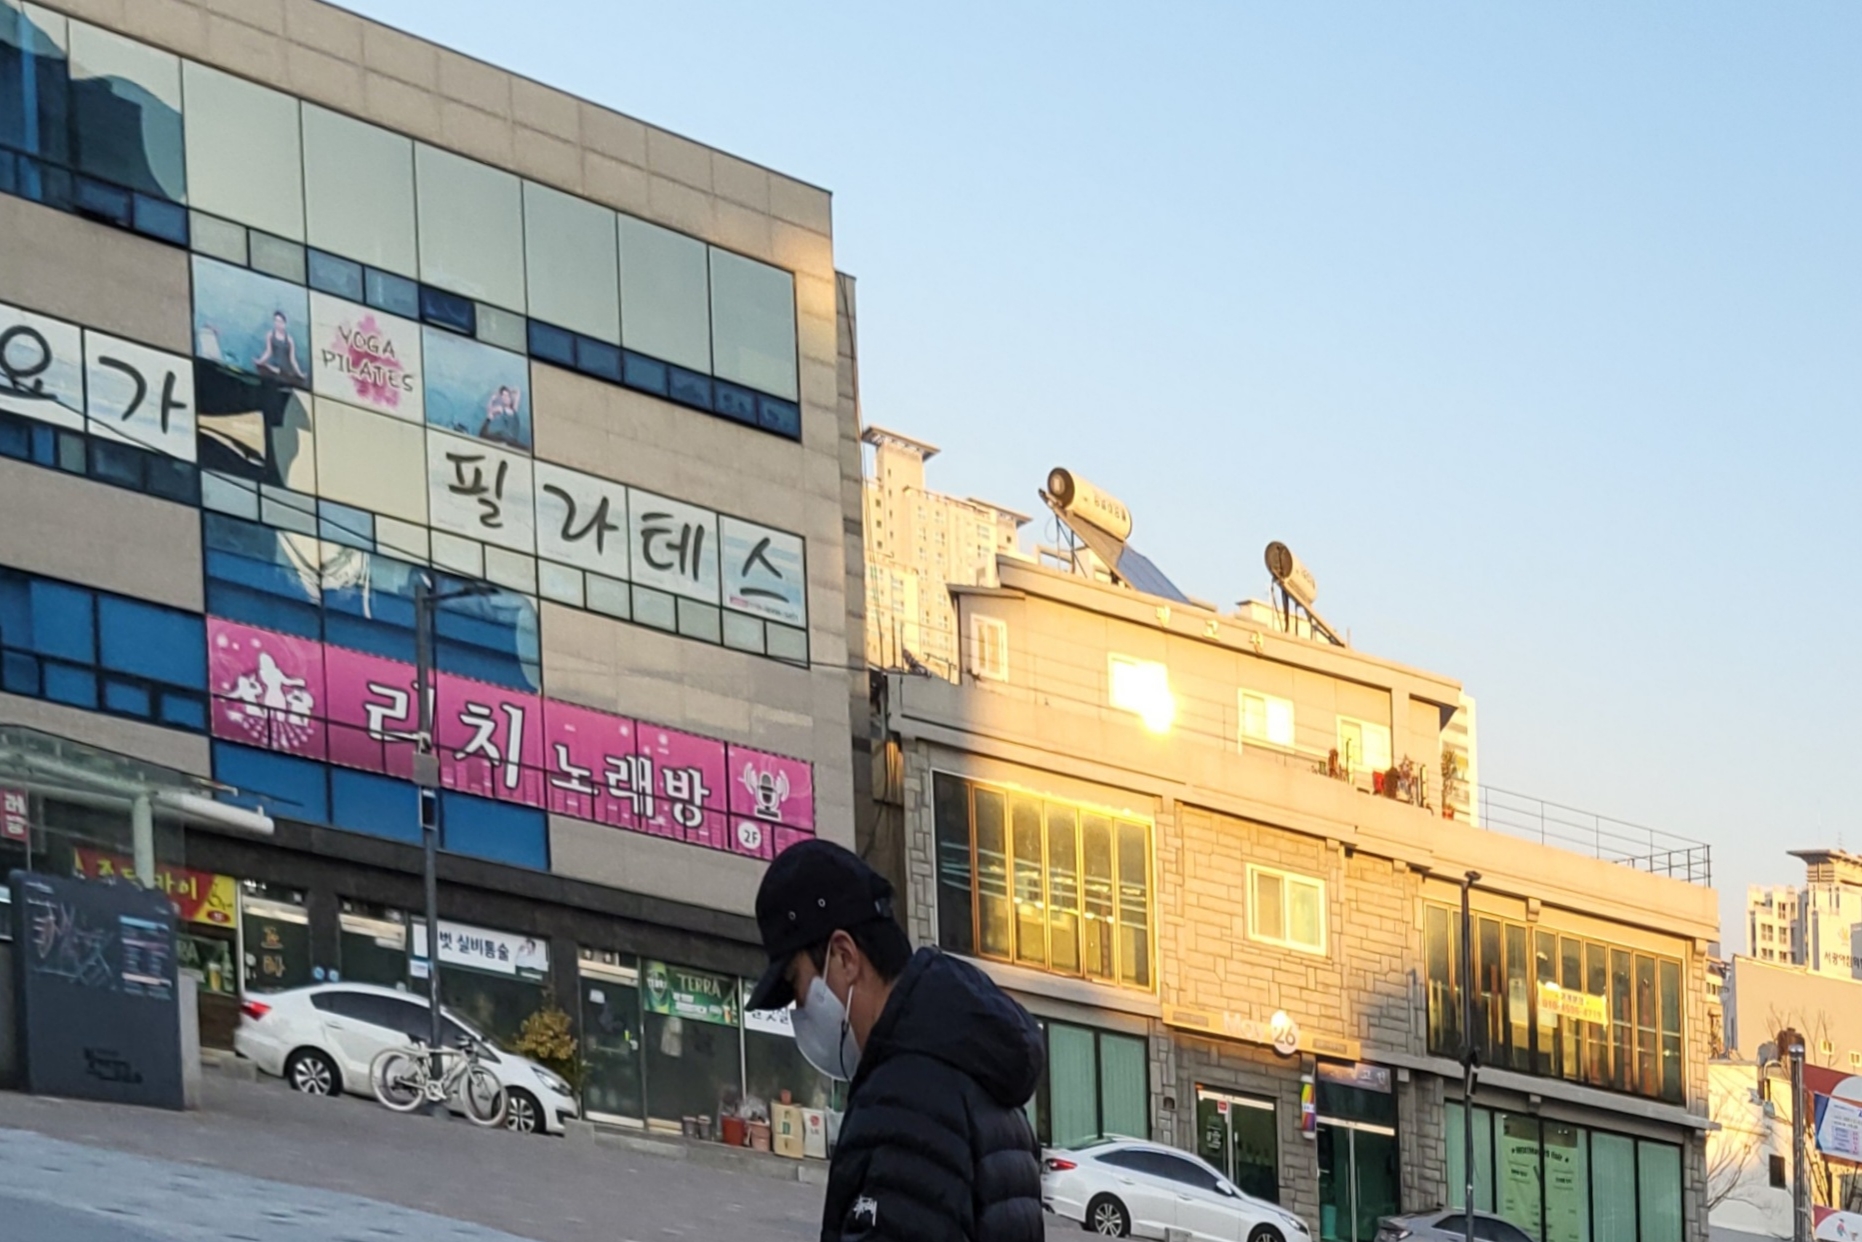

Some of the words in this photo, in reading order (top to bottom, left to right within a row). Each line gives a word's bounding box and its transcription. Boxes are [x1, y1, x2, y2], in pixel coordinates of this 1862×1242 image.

[338, 325, 395, 358] YOGA
[0, 325, 187, 434] 요가
[321, 348, 413, 392] PILATES
[446, 451, 790, 603] 필라테스
[550, 743, 711, 827] 노래방
[743, 829, 760, 845] 2F
[676, 973, 722, 998] TERRA
[1274, 1025, 1296, 1047] 26
